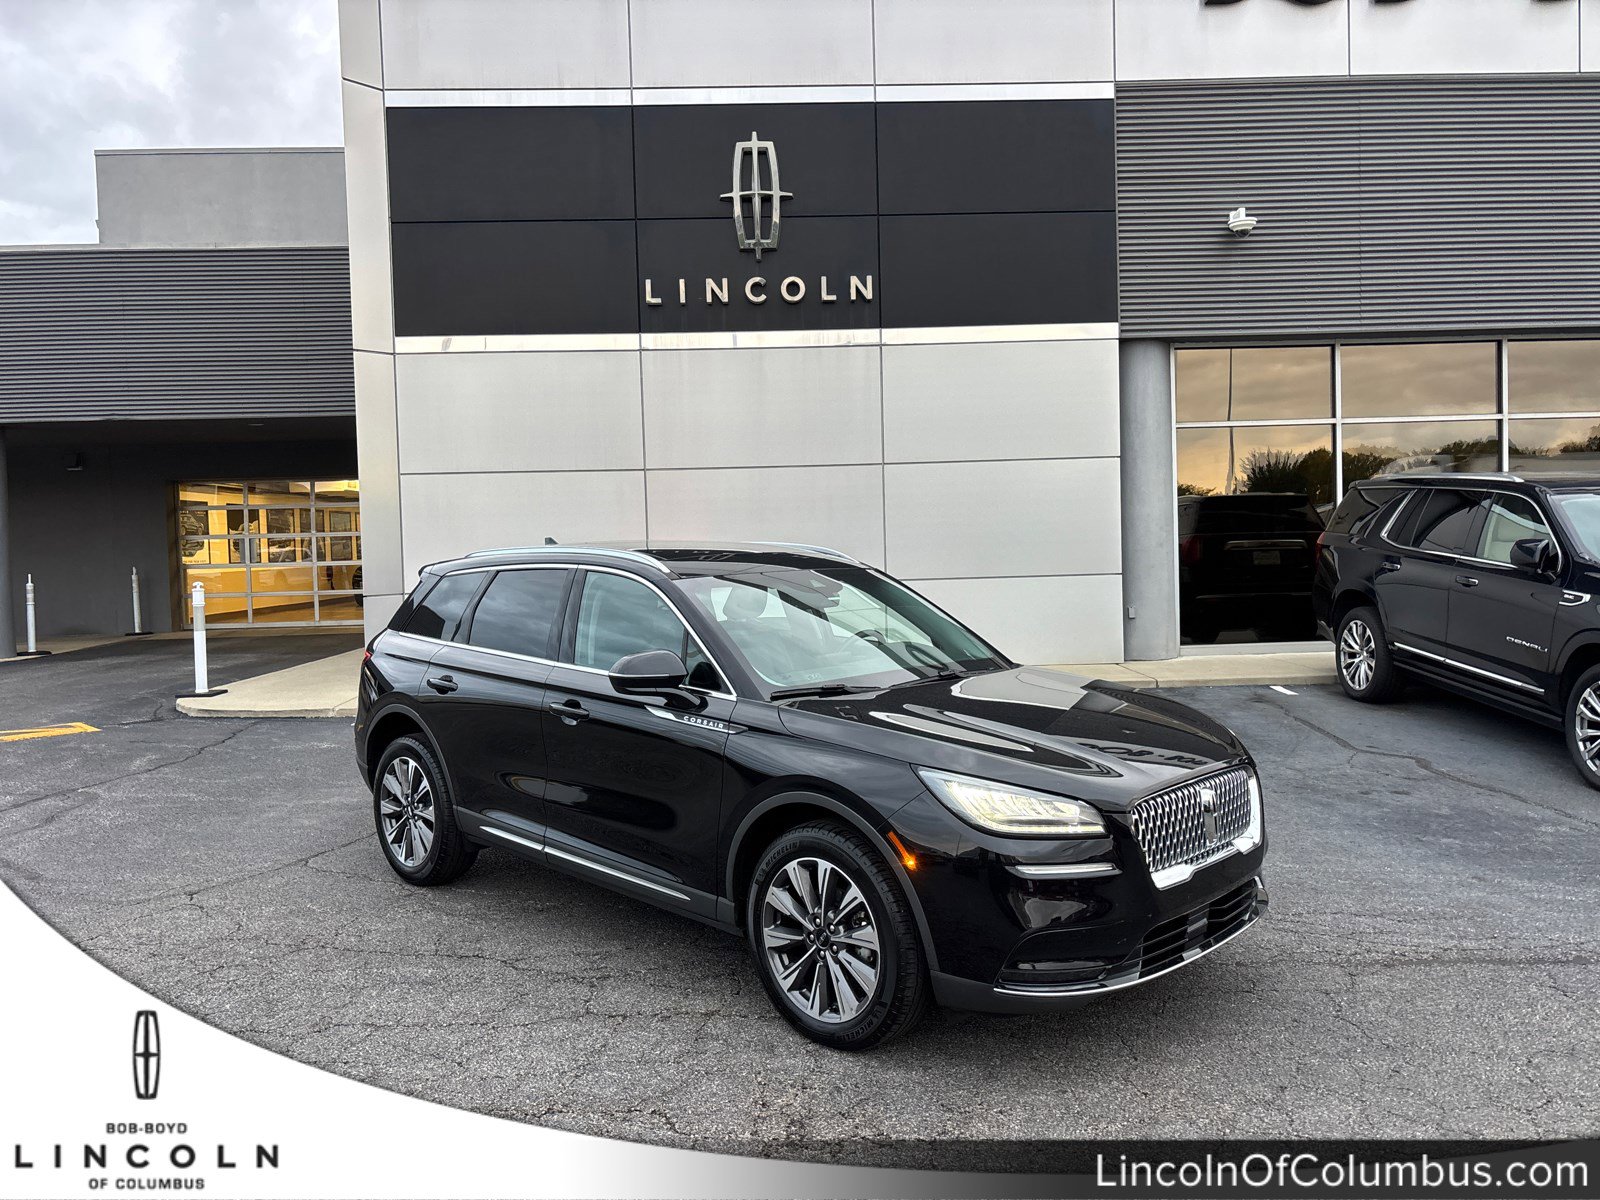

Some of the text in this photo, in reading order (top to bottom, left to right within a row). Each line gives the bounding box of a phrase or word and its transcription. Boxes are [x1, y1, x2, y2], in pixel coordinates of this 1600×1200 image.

[645, 275, 873, 305] LINCOLN
[683, 716, 724, 729] CORSAIR
[765, 841, 800, 868] MICHELIN
